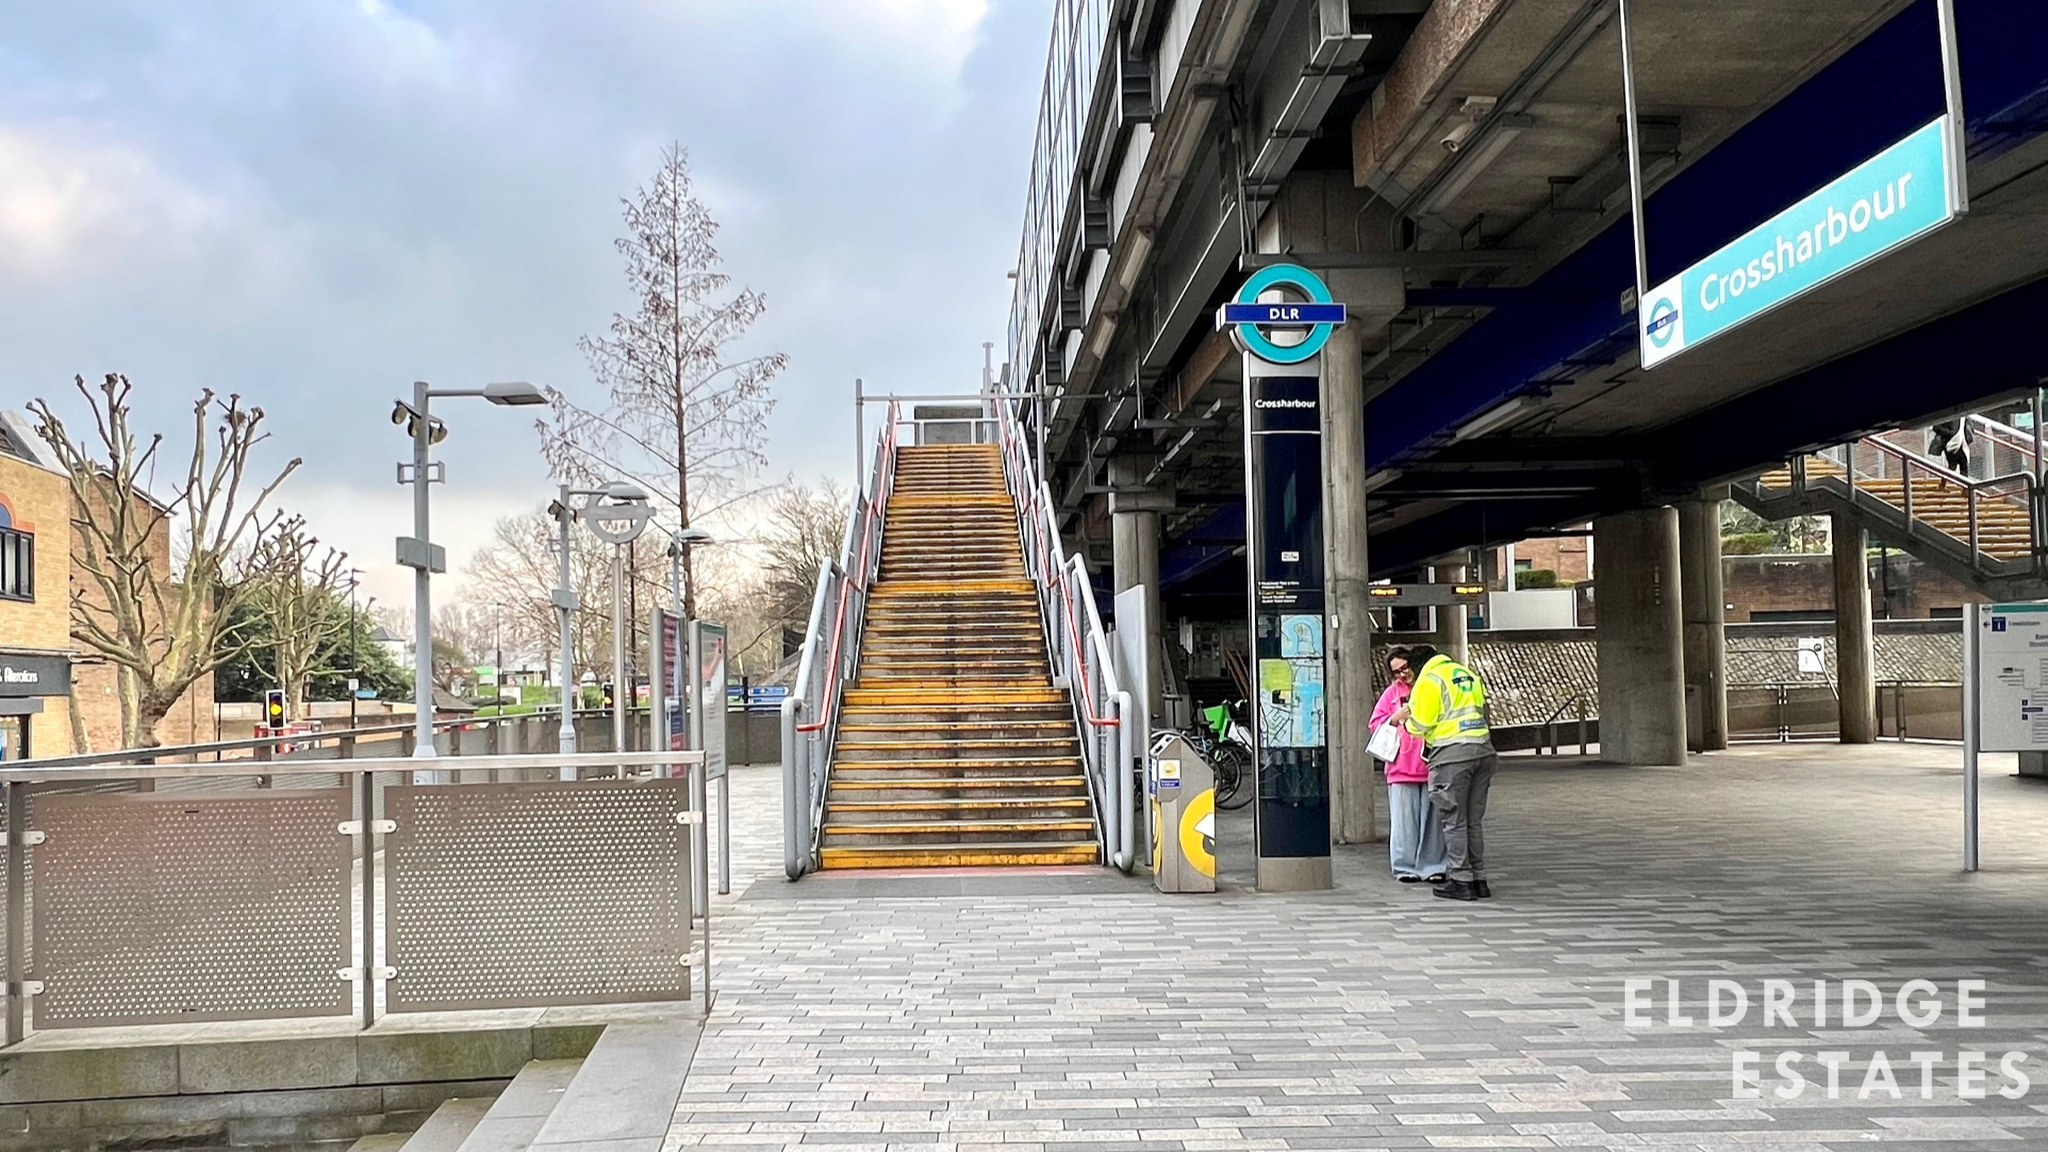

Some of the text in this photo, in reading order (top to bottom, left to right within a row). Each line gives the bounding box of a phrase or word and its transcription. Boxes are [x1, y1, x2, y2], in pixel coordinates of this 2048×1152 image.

[1700, 171, 1912, 311] Crossharbour
[1269, 308, 1300, 320] DLR
[1254, 399, 1316, 408] Crossharbour
